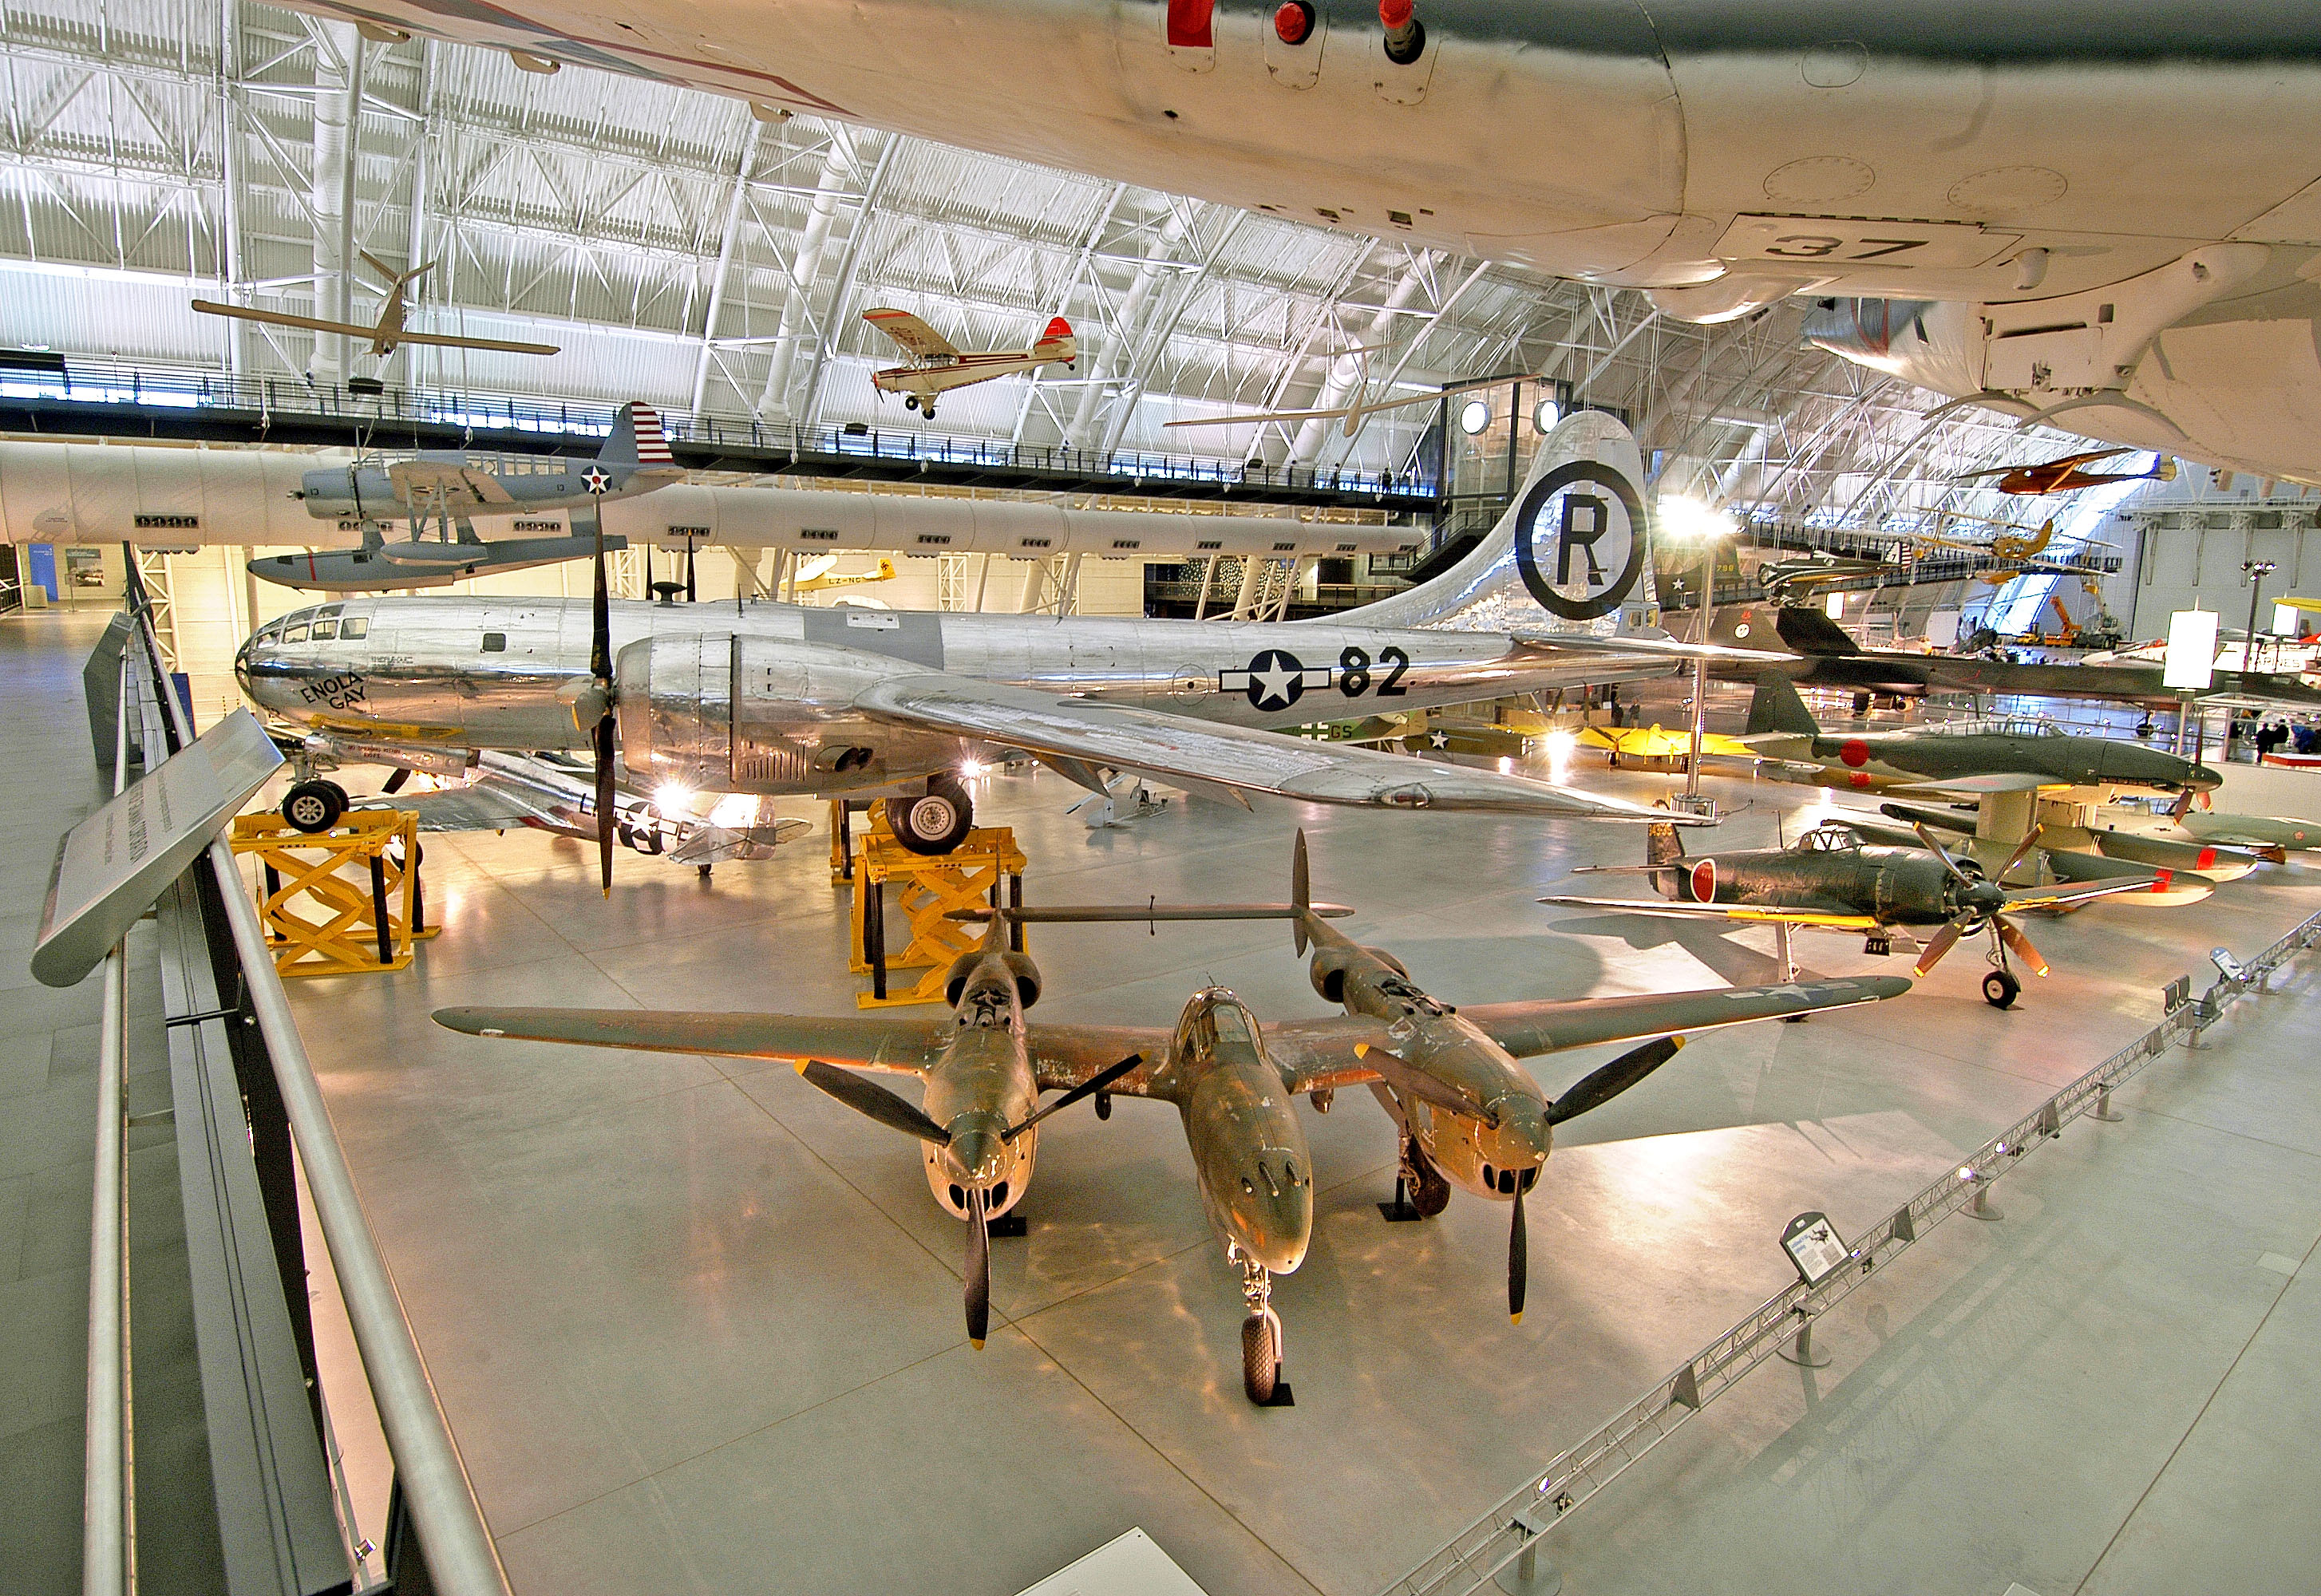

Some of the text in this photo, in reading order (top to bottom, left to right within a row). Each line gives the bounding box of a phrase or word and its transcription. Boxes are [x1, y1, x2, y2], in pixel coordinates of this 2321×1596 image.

[1765, 235, 1929, 259] 37
[1557, 493, 1608, 586] R
[1339, 646, 1410, 697] 82
[300, 671, 365, 704] ENOLA
[329, 686, 366, 709] GAY
[1331, 725, 1352, 739] GS
